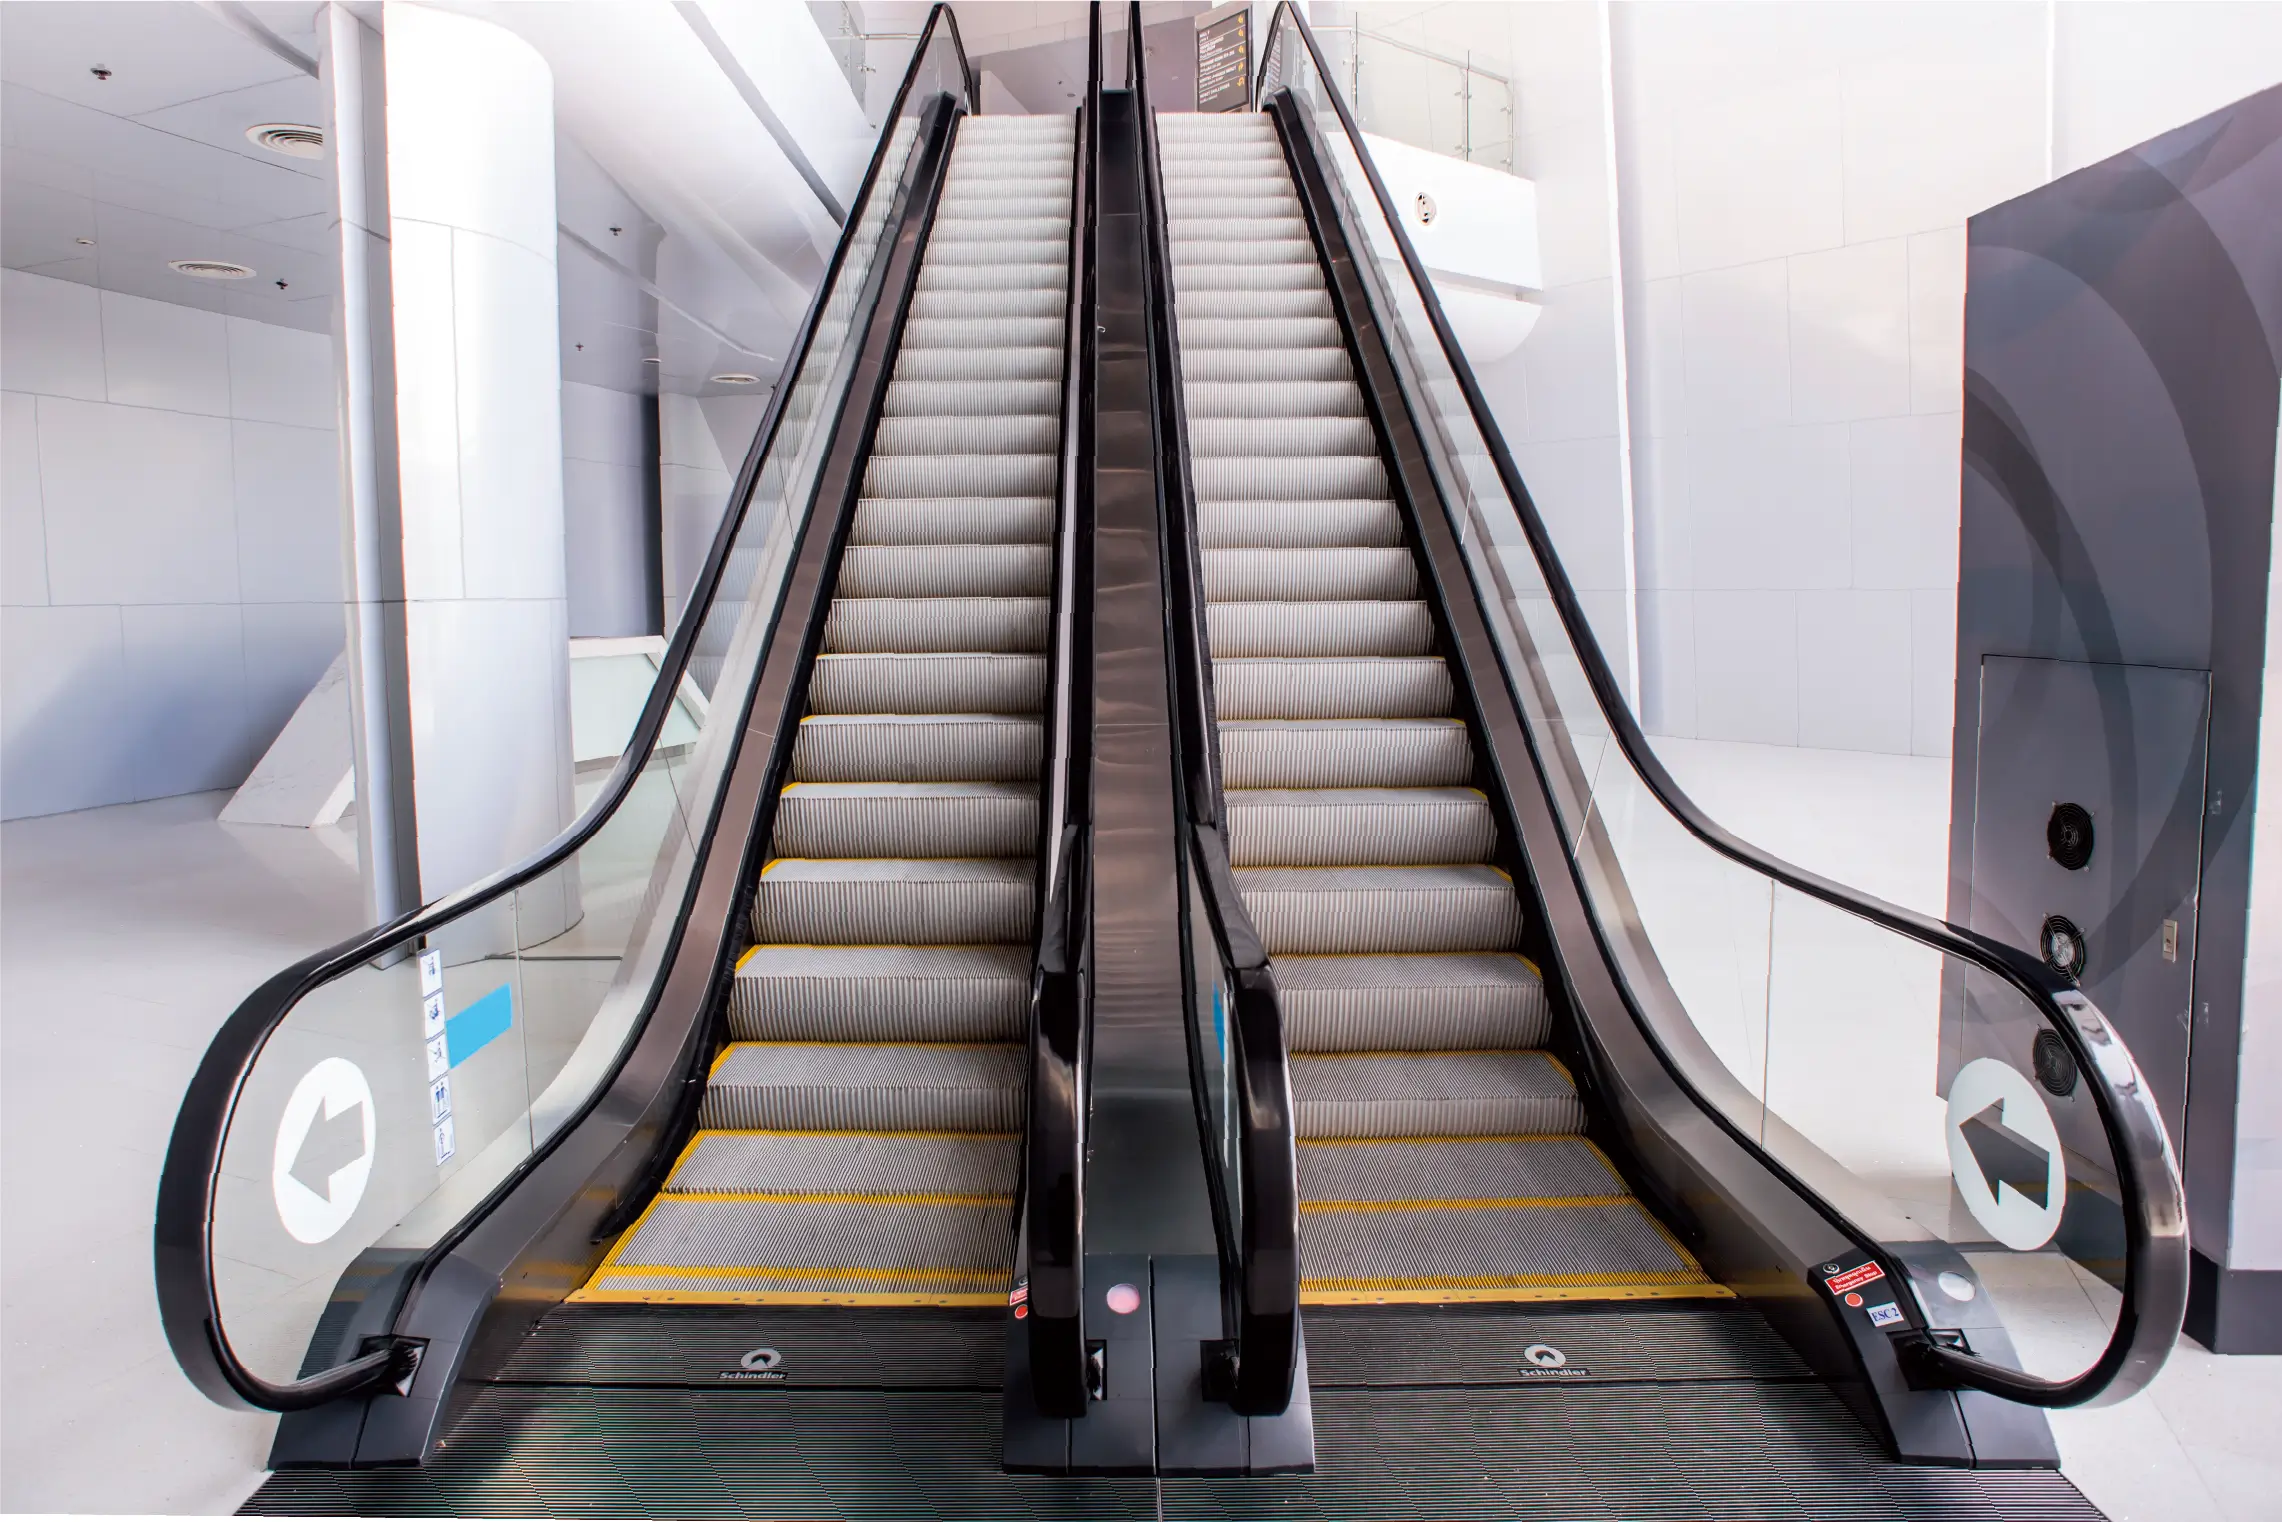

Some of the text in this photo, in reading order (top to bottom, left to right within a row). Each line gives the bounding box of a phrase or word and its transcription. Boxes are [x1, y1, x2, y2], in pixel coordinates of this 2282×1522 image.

[1835, 1271, 1877, 1289] Emergency Stop
[1871, 1308, 1899, 1321] ESC 2
